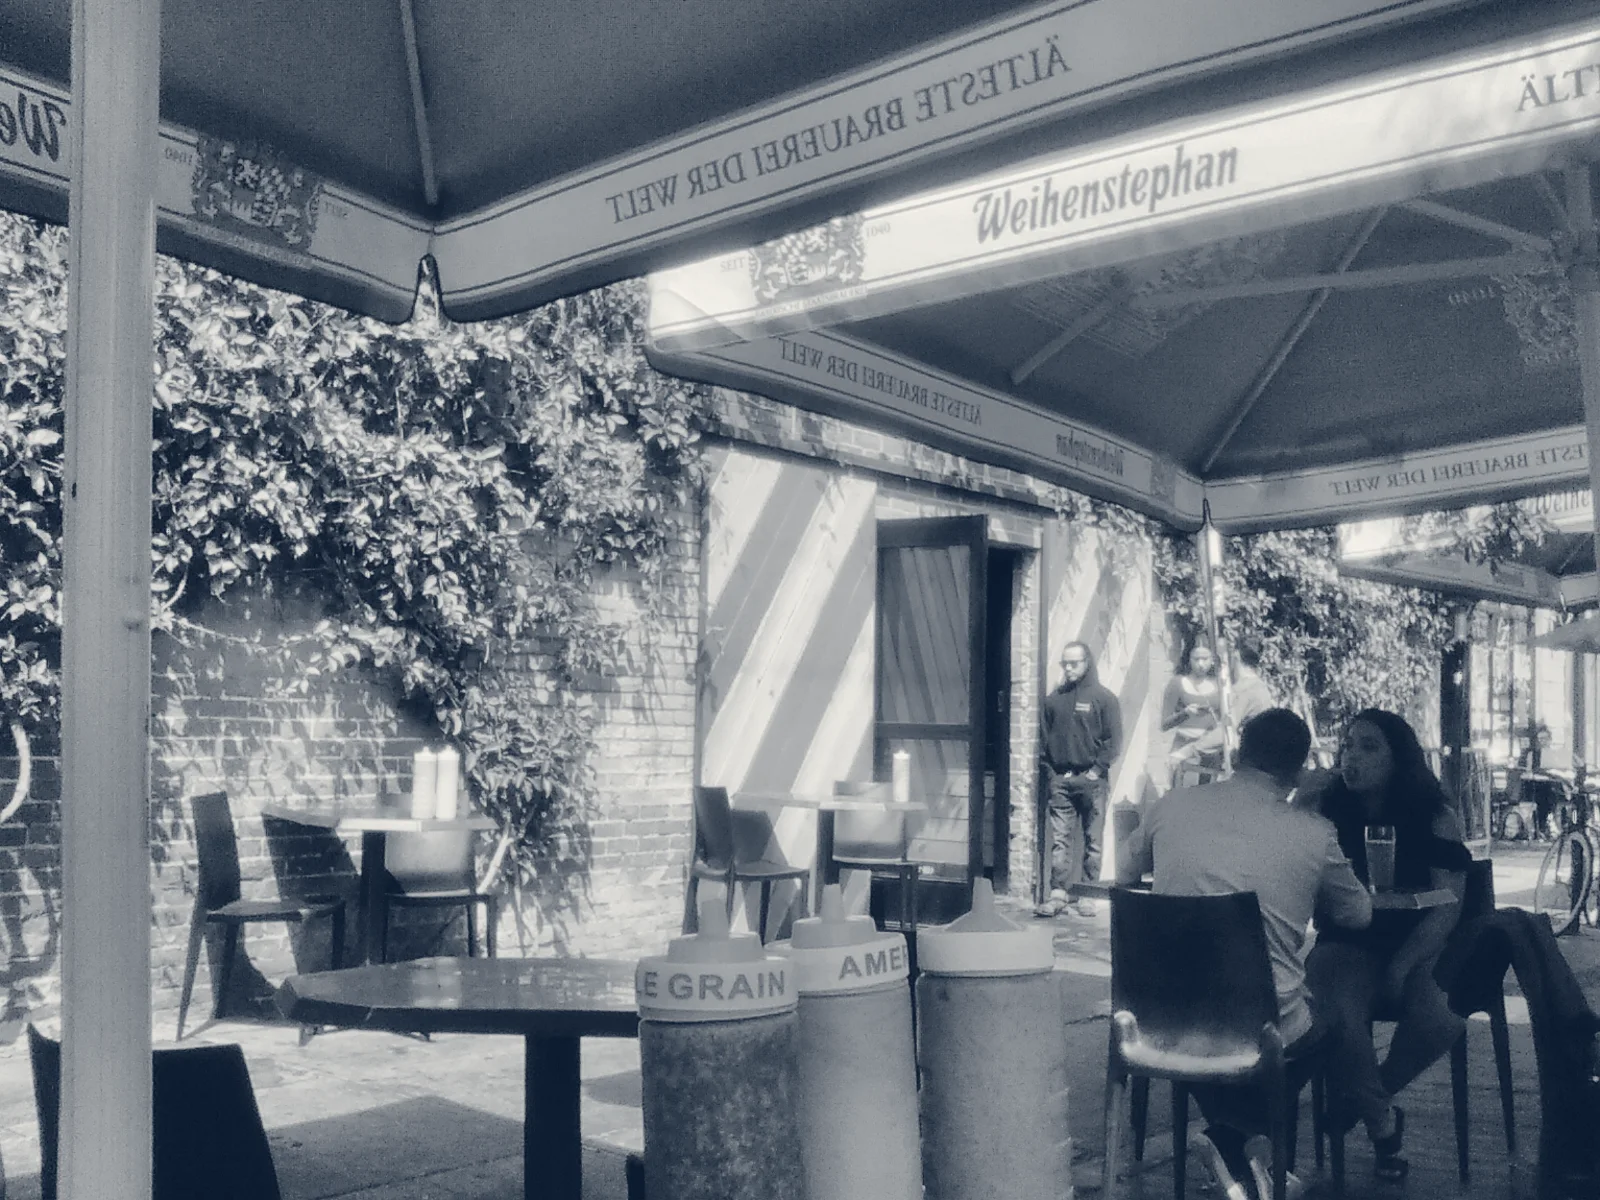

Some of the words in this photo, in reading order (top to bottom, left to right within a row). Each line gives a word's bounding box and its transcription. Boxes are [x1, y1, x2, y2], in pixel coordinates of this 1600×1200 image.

[1514, 64, 1600, 113] ÄLT
[972, 143, 1238, 244] Weihenstephan
[668, 970, 785, 1000] GRAIN
